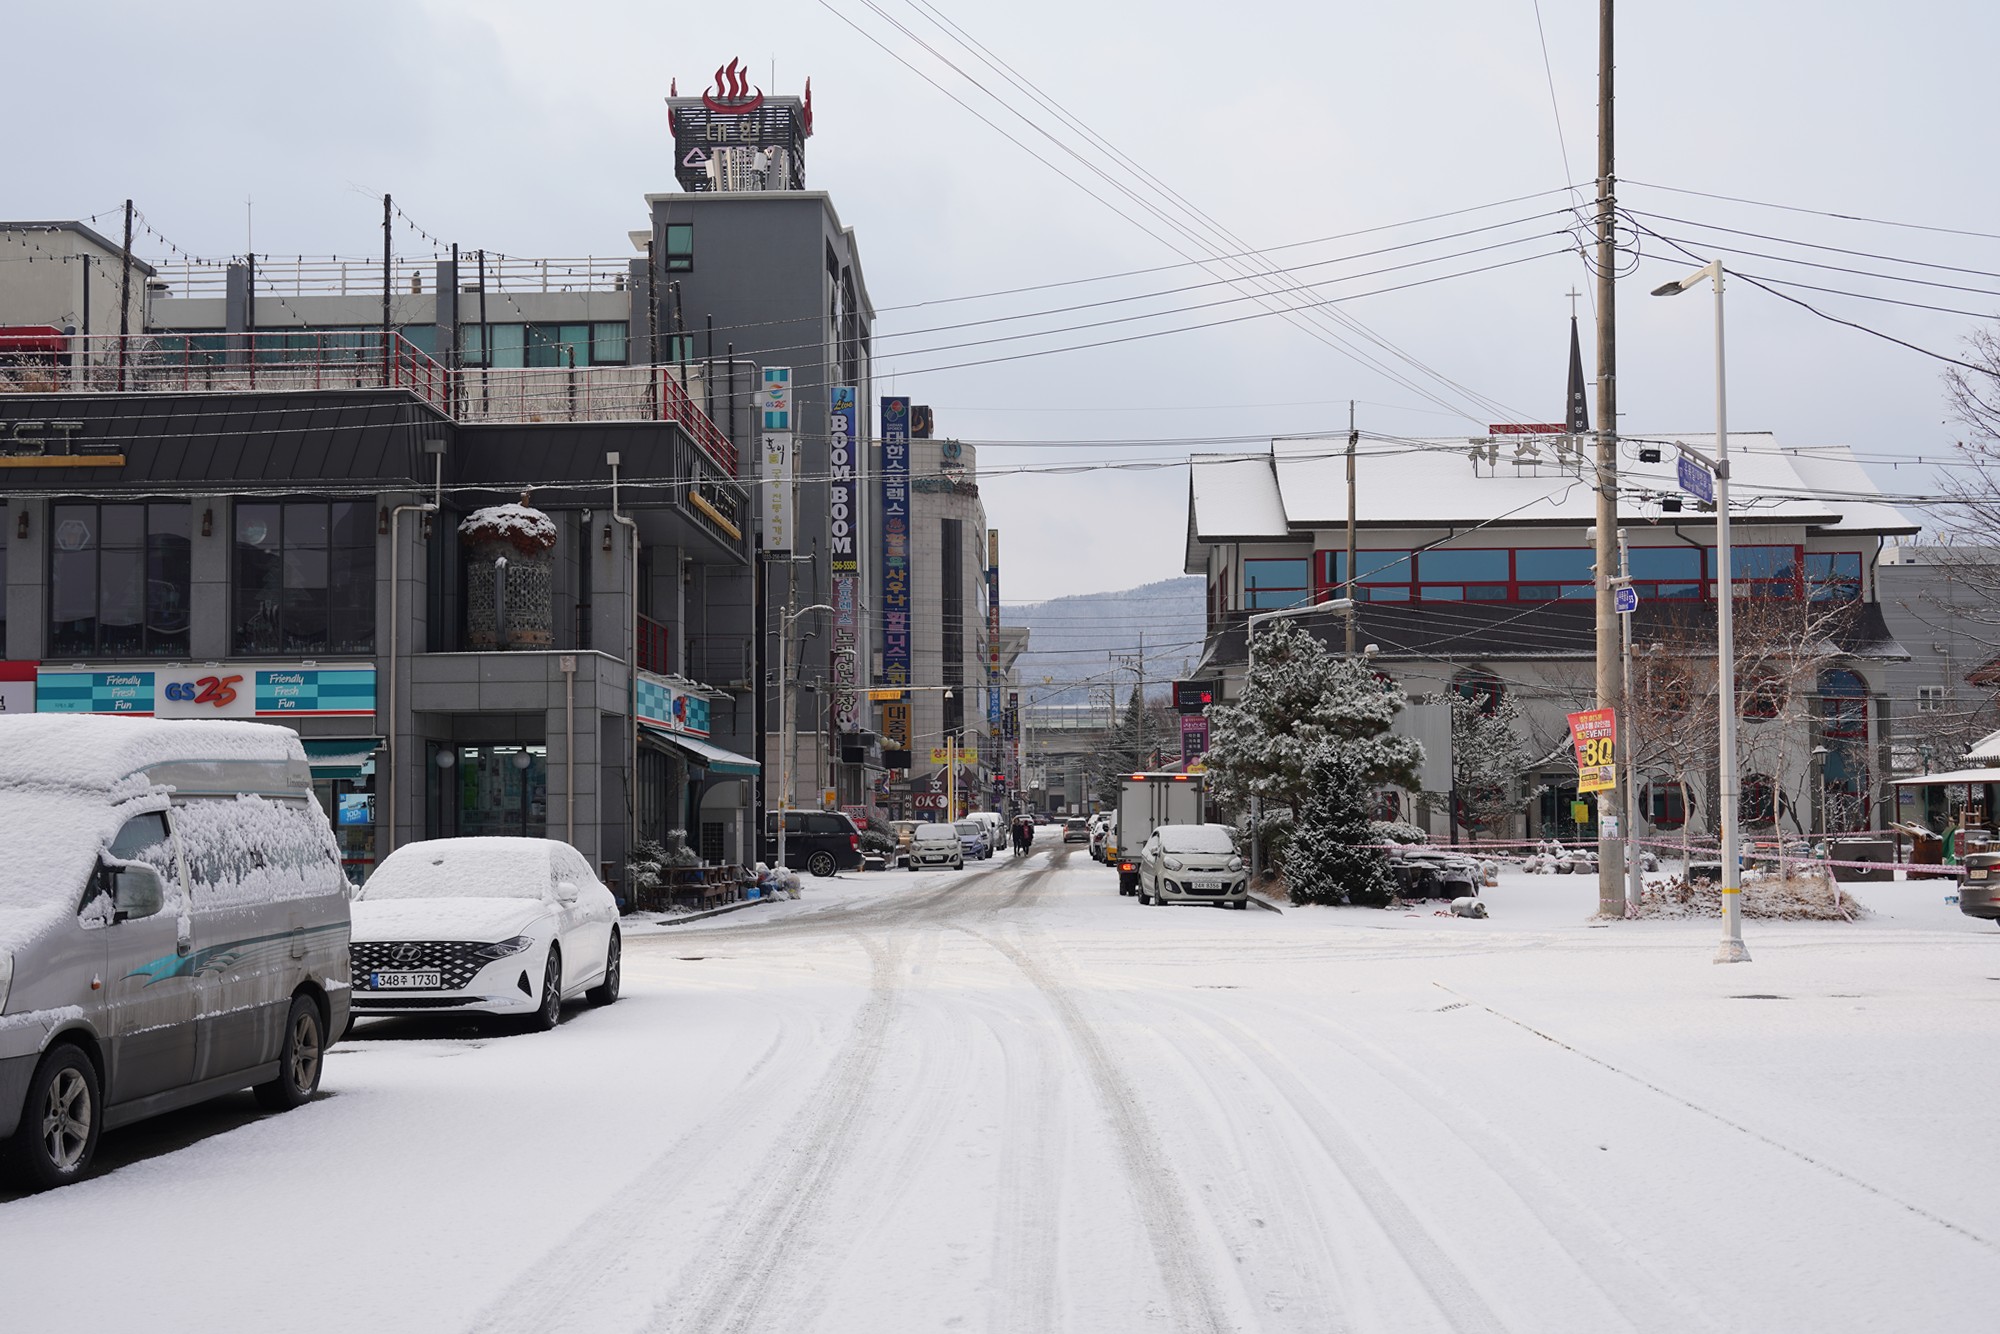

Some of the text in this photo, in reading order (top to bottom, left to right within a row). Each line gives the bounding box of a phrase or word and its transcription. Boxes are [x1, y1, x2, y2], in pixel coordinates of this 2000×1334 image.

[833, 399, 854, 411] Live
[0, 421, 84, 456] ST
[830, 414, 851, 482] BOOM
[886, 431, 905, 515] 대한스포렉스
[831, 486, 852, 554] BOOM
[886, 569, 907, 607] 사우나
[835, 628, 856, 712] 노래연습장
[106, 675, 141, 687] Friendly
[269, 673, 304, 685] Friendly
[111, 687, 136, 698] Fresh
[165, 675, 243, 708] GS25
[274, 685, 299, 697] Fresh
[114, 700, 132, 710] Fun
[278, 699, 296, 709] Fun
[915, 795, 935, 807] OK
[411, 975, 438, 986] 1730
